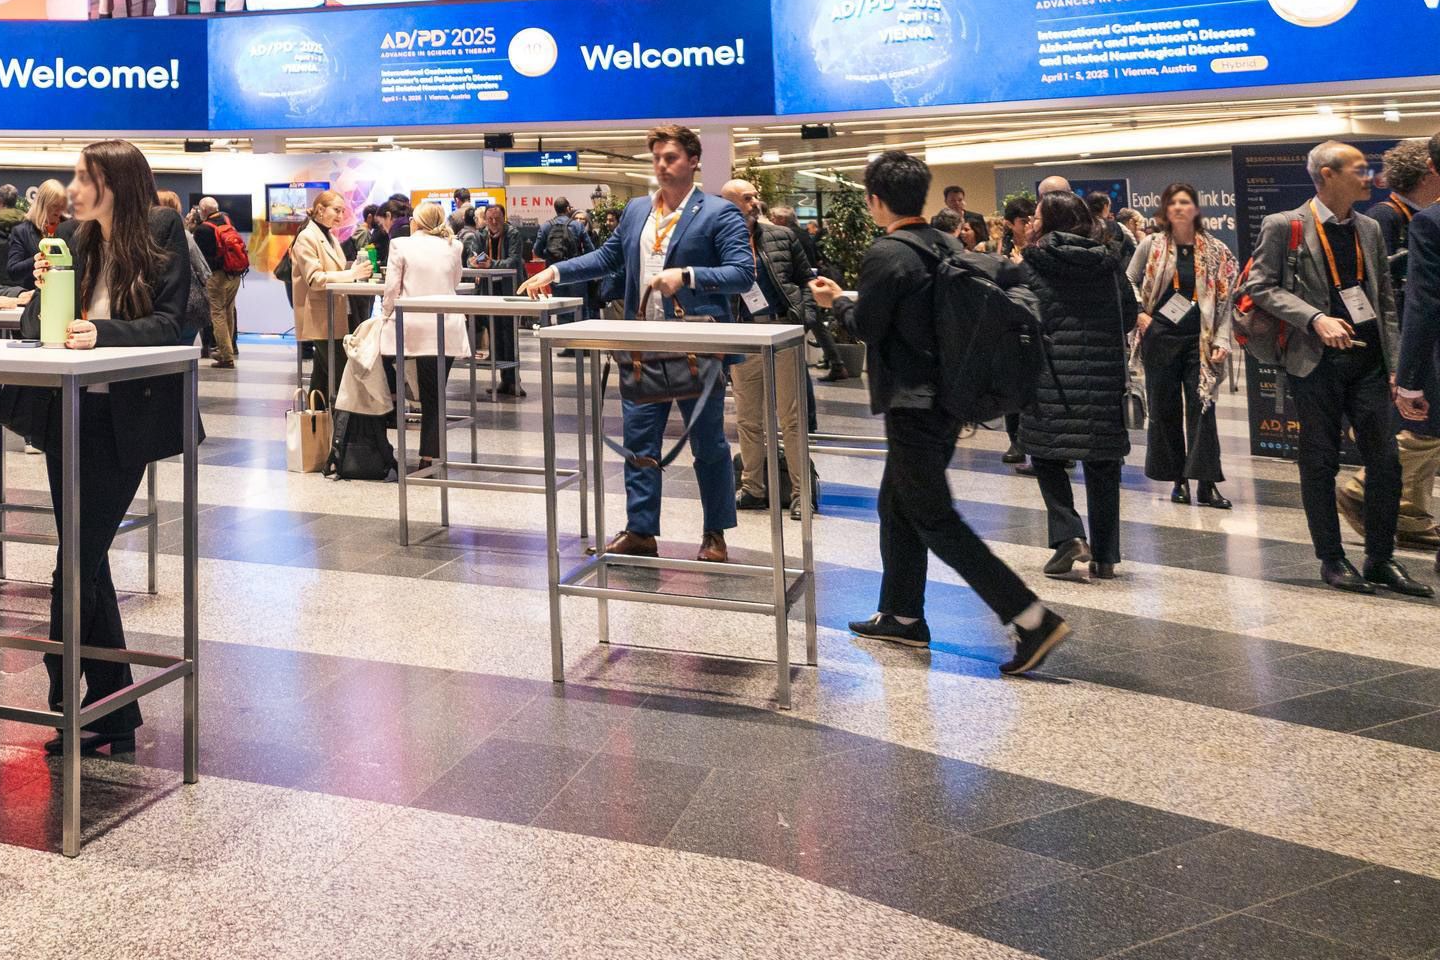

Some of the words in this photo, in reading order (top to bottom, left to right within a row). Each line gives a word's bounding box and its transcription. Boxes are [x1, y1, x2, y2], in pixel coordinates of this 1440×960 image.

[451, 27, 497, 46] 2025
[879, 25, 935, 44] VIENNA
[1037, 25, 1110, 41] International
[1112, 20, 1181, 34] Conference
[1183, 19, 1200, 28] on
[1039, 39, 1104, 54] Alzheimer's
[1104, 37, 1128, 49] and
[1129, 32, 1198, 47] Parkinson's
[1199, 27, 1256, 40] Diseases
[465, 47, 496, 55] THERAPY
[580, 38, 745, 71] Welcome!
[1039, 56, 1062, 67] and
[1063, 52, 1109, 66] Related
[1109, 46, 1187, 63] Neurological
[1188, 42, 1248, 56] Disorders
[1041, 72, 1062, 84] April
[1085, 69, 1108, 80] 2025
[1122, 67, 1159, 77] Vienna,
[1161, 64, 1197, 74] Austria
[1198, 190, 1219, 207] link
